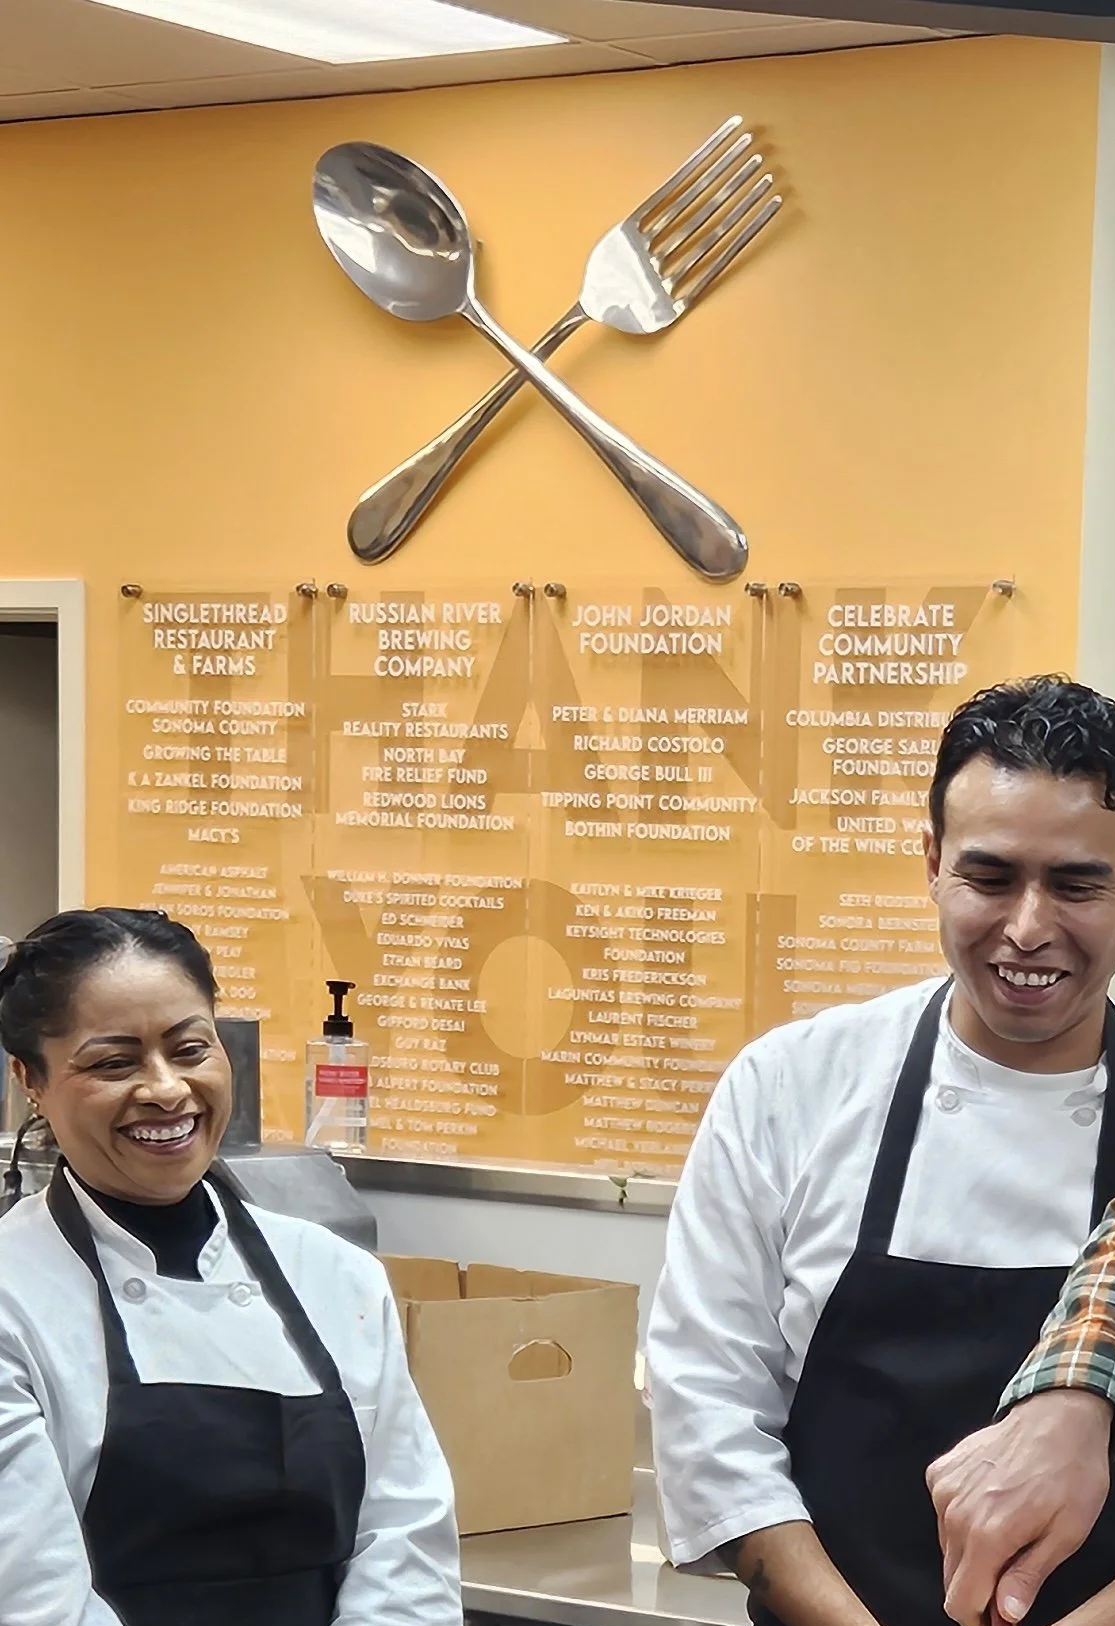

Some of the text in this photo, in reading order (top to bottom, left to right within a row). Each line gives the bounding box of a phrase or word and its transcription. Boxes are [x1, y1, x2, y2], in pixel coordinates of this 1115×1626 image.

[142, 602, 287, 624] SINGLETHREAD
[349, 603, 502, 624] RUSSIAN RIVER
[572, 604, 732, 628] JOHN JORDAN
[827, 604, 955, 628] CELEBRATE
[153, 629, 276, 651] RESTAURANT
[378, 629, 472, 651] BREWING
[579, 632, 722, 655] FOUNDATION
[818, 632, 964, 656] COMMUNITY
[173, 655, 256, 676] & FARMS
[374, 656, 475, 678] COMPANY
[813, 661, 968, 686] PARTNERSHIP
[126, 699, 305, 717] COMMUNITY FOUNDATION
[401, 702, 448, 718] STARK
[552, 706, 748, 725] PETER & DIANA MERRIAM
[152, 718, 278, 735] SONOMA COUNTY
[786, 710, 951, 728] COLUMBIA DISTRIBU
[343, 721, 509, 739] REALITY RESTAURANTS
[143, 744, 287, 763] GROWING THE TABLE
[574, 735, 725, 754] RICHARD COSTOLO
[823, 737, 938, 756] GEORGE SARL
[384, 747, 466, 764] NORTH BAY
[128, 771, 302, 791] K A ZANKEL FOUNDATION
[362, 766, 487, 784] FIRE RELIEF FUND
[584, 764, 712, 782] GEORGE BULL III
[363, 791, 486, 809] REDWOOD LIONS
[541, 791, 758, 813] TIPPING POINT COMMUNITY
[789, 788, 929, 807] JACKSON FAMILY
[128, 798, 302, 818] KING RIDGE FOUNDATION
[335, 811, 514, 830] MEMORIAL FOUNDATION
[837, 817, 896, 833] UNITED
[188, 828, 240, 844] MACY'S
[565, 821, 731, 841] BOTHIN FOUNDATION
[792, 836, 895, 854] OF THE WINE
[328, 870, 375, 882] WILLIAM
[444, 873, 523, 889] FOUNDATION
[571, 883, 620, 896] KAITLYN
[636, 886, 666, 899] MIKE
[387, 892, 436, 906] SPIRITED
[439, 894, 504, 909] COCKTAILS
[218, 904, 290, 920] FOUNDATION
[382, 913, 396, 925] ED
[576, 904, 600, 917] KEN
[657, 907, 717, 922] FREEMAN
[377, 932, 469, 950] EDUARDO VIVAS
[566, 925, 726, 945] KEYSIGHT TECHNOLOGIES
[777, 936, 836, 950] SONOMA
[840, 938, 896, 952] COUNTY
[383, 954, 421, 967] ETHAN
[604, 948, 685, 964] FOUNDATION
[374, 974, 470, 991] EXCHANGE BANK
[583, 968, 708, 986] KRIS FREDERICKSON
[358, 994, 405, 1009] GEORGE
[548, 987, 616, 1004] LAGUNITAS
[619, 991, 675, 1006] BREWING
[432, 1017, 465, 1032] DESAI
[589, 1010, 698, 1029] LAURENT FISCHER
[623, 1033, 666, 1049] ESTATE
[541, 1050, 580, 1064] MARIN
[470, 1062, 500, 1077] CLUB
[423, 1078, 499, 1096] FOUNDATION
[565, 1073, 624, 1086] MATTHEW
